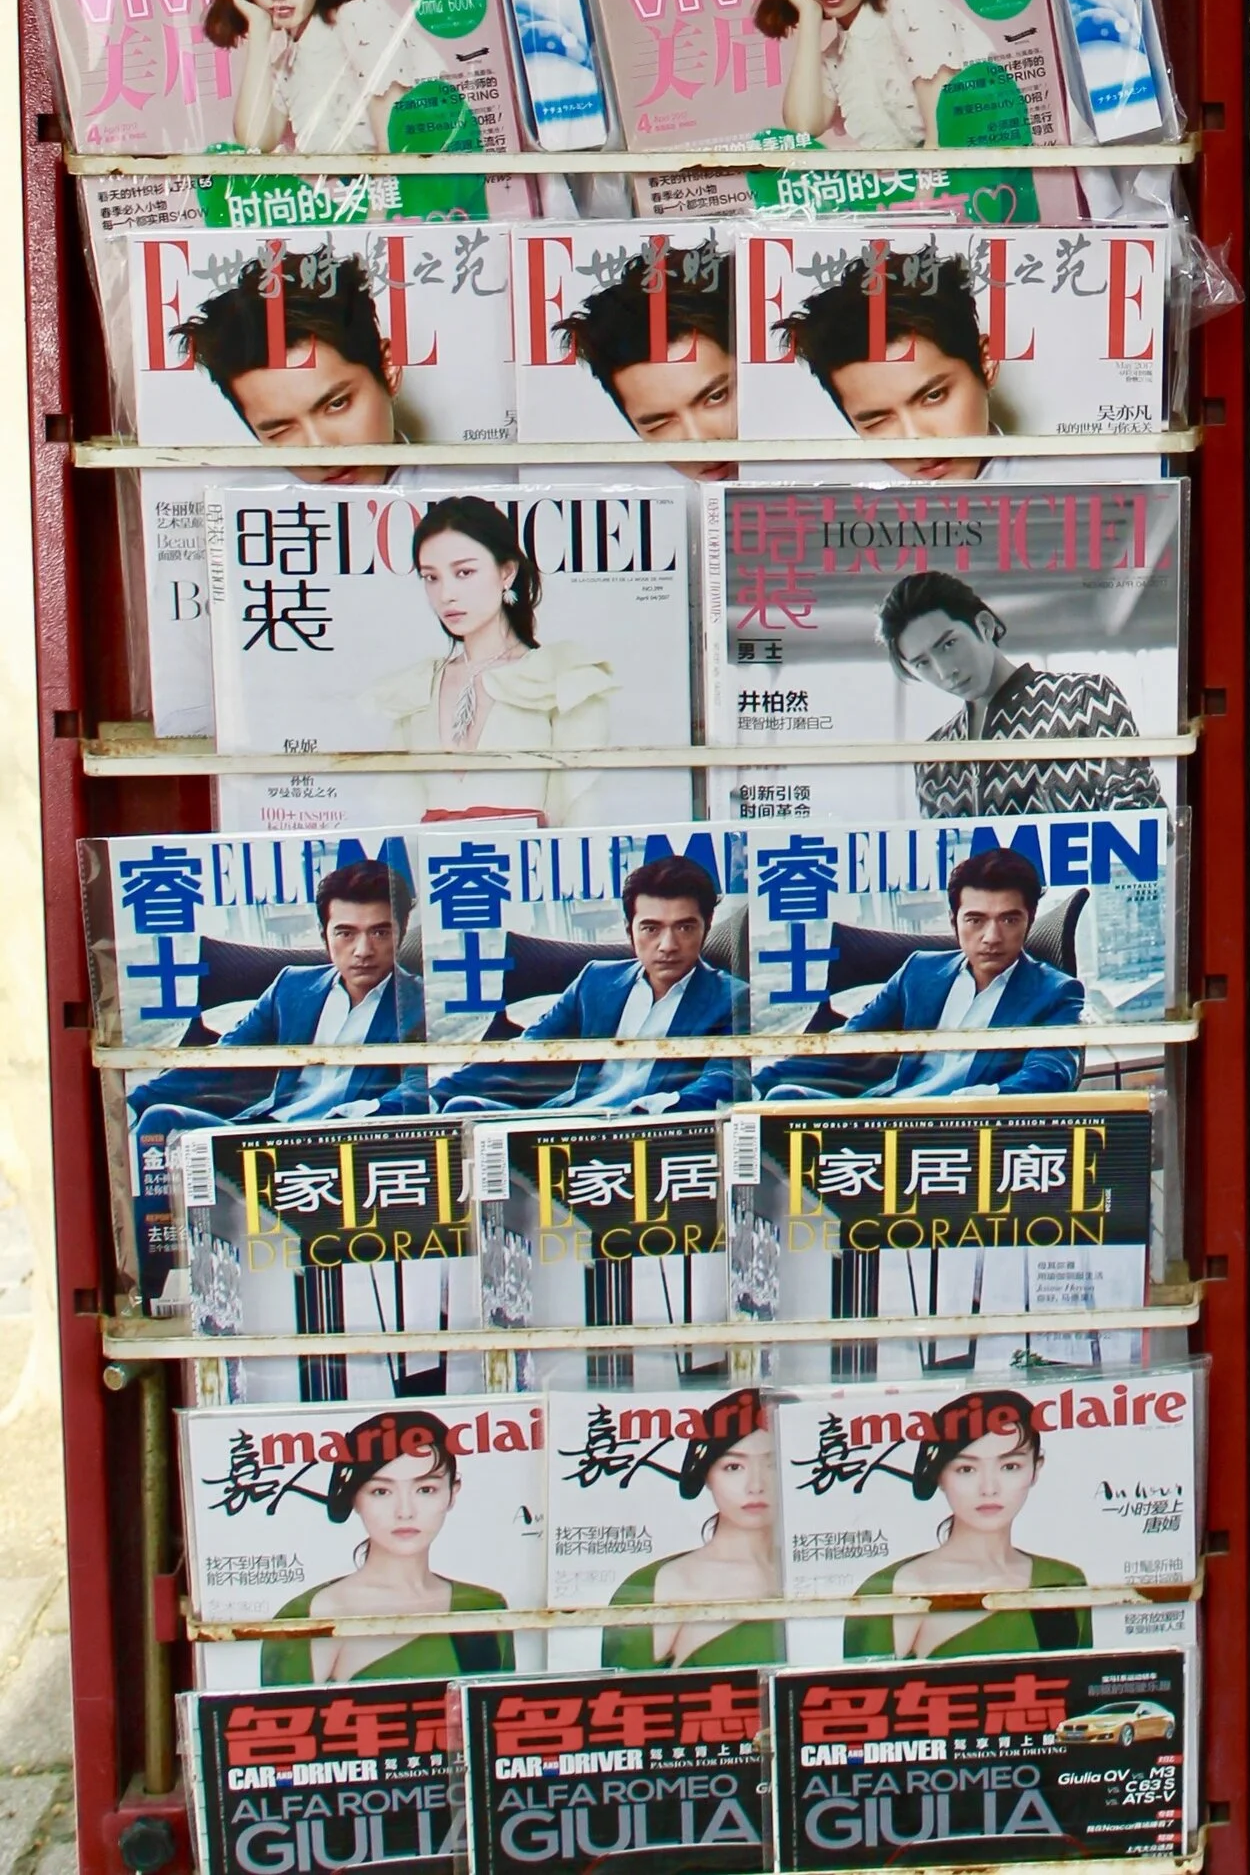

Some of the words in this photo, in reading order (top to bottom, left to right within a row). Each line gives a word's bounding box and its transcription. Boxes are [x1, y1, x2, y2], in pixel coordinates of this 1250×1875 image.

[650, 184, 717, 203] 春季必入小物
[741, 236, 1154, 364] ELLE
[1097, 404, 1152, 422] 吴亦凡
[822, 520, 983, 549] HOMMES
[737, 643, 783, 661] 男士
[738, 691, 809, 713] 井柏然
[738, 716, 833, 730] 理智地打磨自己
[267, 788, 338, 799] 罗曼蒂克之名
[740, 785, 810, 801] 创新引领
[260, 807, 295, 821] 100+
[299, 809, 347, 821] INSPIRE
[740, 804, 810, 819] 时间革命
[848, 819, 1159, 894] ELLEMEN
[119, 845, 210, 1020] 睿士
[429, 841, 515, 1015] 睿士
[242, 1140, 261, 1148] THE
[266, 1136, 313, 1146] WORLD'S
[319, 1132, 389, 1144] BEST-SELLING
[395, 1129, 446, 1139] LIFESTYLE
[785, 1126, 1105, 1217] ELLE
[818, 1145, 1068, 1196] 家居廊
[787, 1216, 1105, 1253] DECORATION
[850, 1395, 1017, 1446] marie
[1031, 1383, 1187, 1433] claire
[261, 1418, 435, 1466] marie
[1102, 1500, 1184, 1517] 一小时爱上
[792, 1531, 887, 1547] 找不到有情人
[206, 1555, 304, 1571] 找不到有情人
[792, 1545, 889, 1561] 能不能做妈妈
[206, 1570, 305, 1586] 能不能做妈妈
[801, 1673, 1069, 1744] 名车志
[802, 1770, 901, 1798] ALFA
[908, 1765, 1041, 1791] ROMEO
[1058, 1771, 1101, 1785] Giulia
[1104, 1769, 1130, 1782] QV
[1149, 1766, 1175, 1779] M3
[232, 1791, 334, 1825] ALFA
[1122, 1791, 1175, 1806] ATS-V
[501, 1799, 761, 1860] GIULIA
[805, 1790, 1064, 1849] GIULIA
